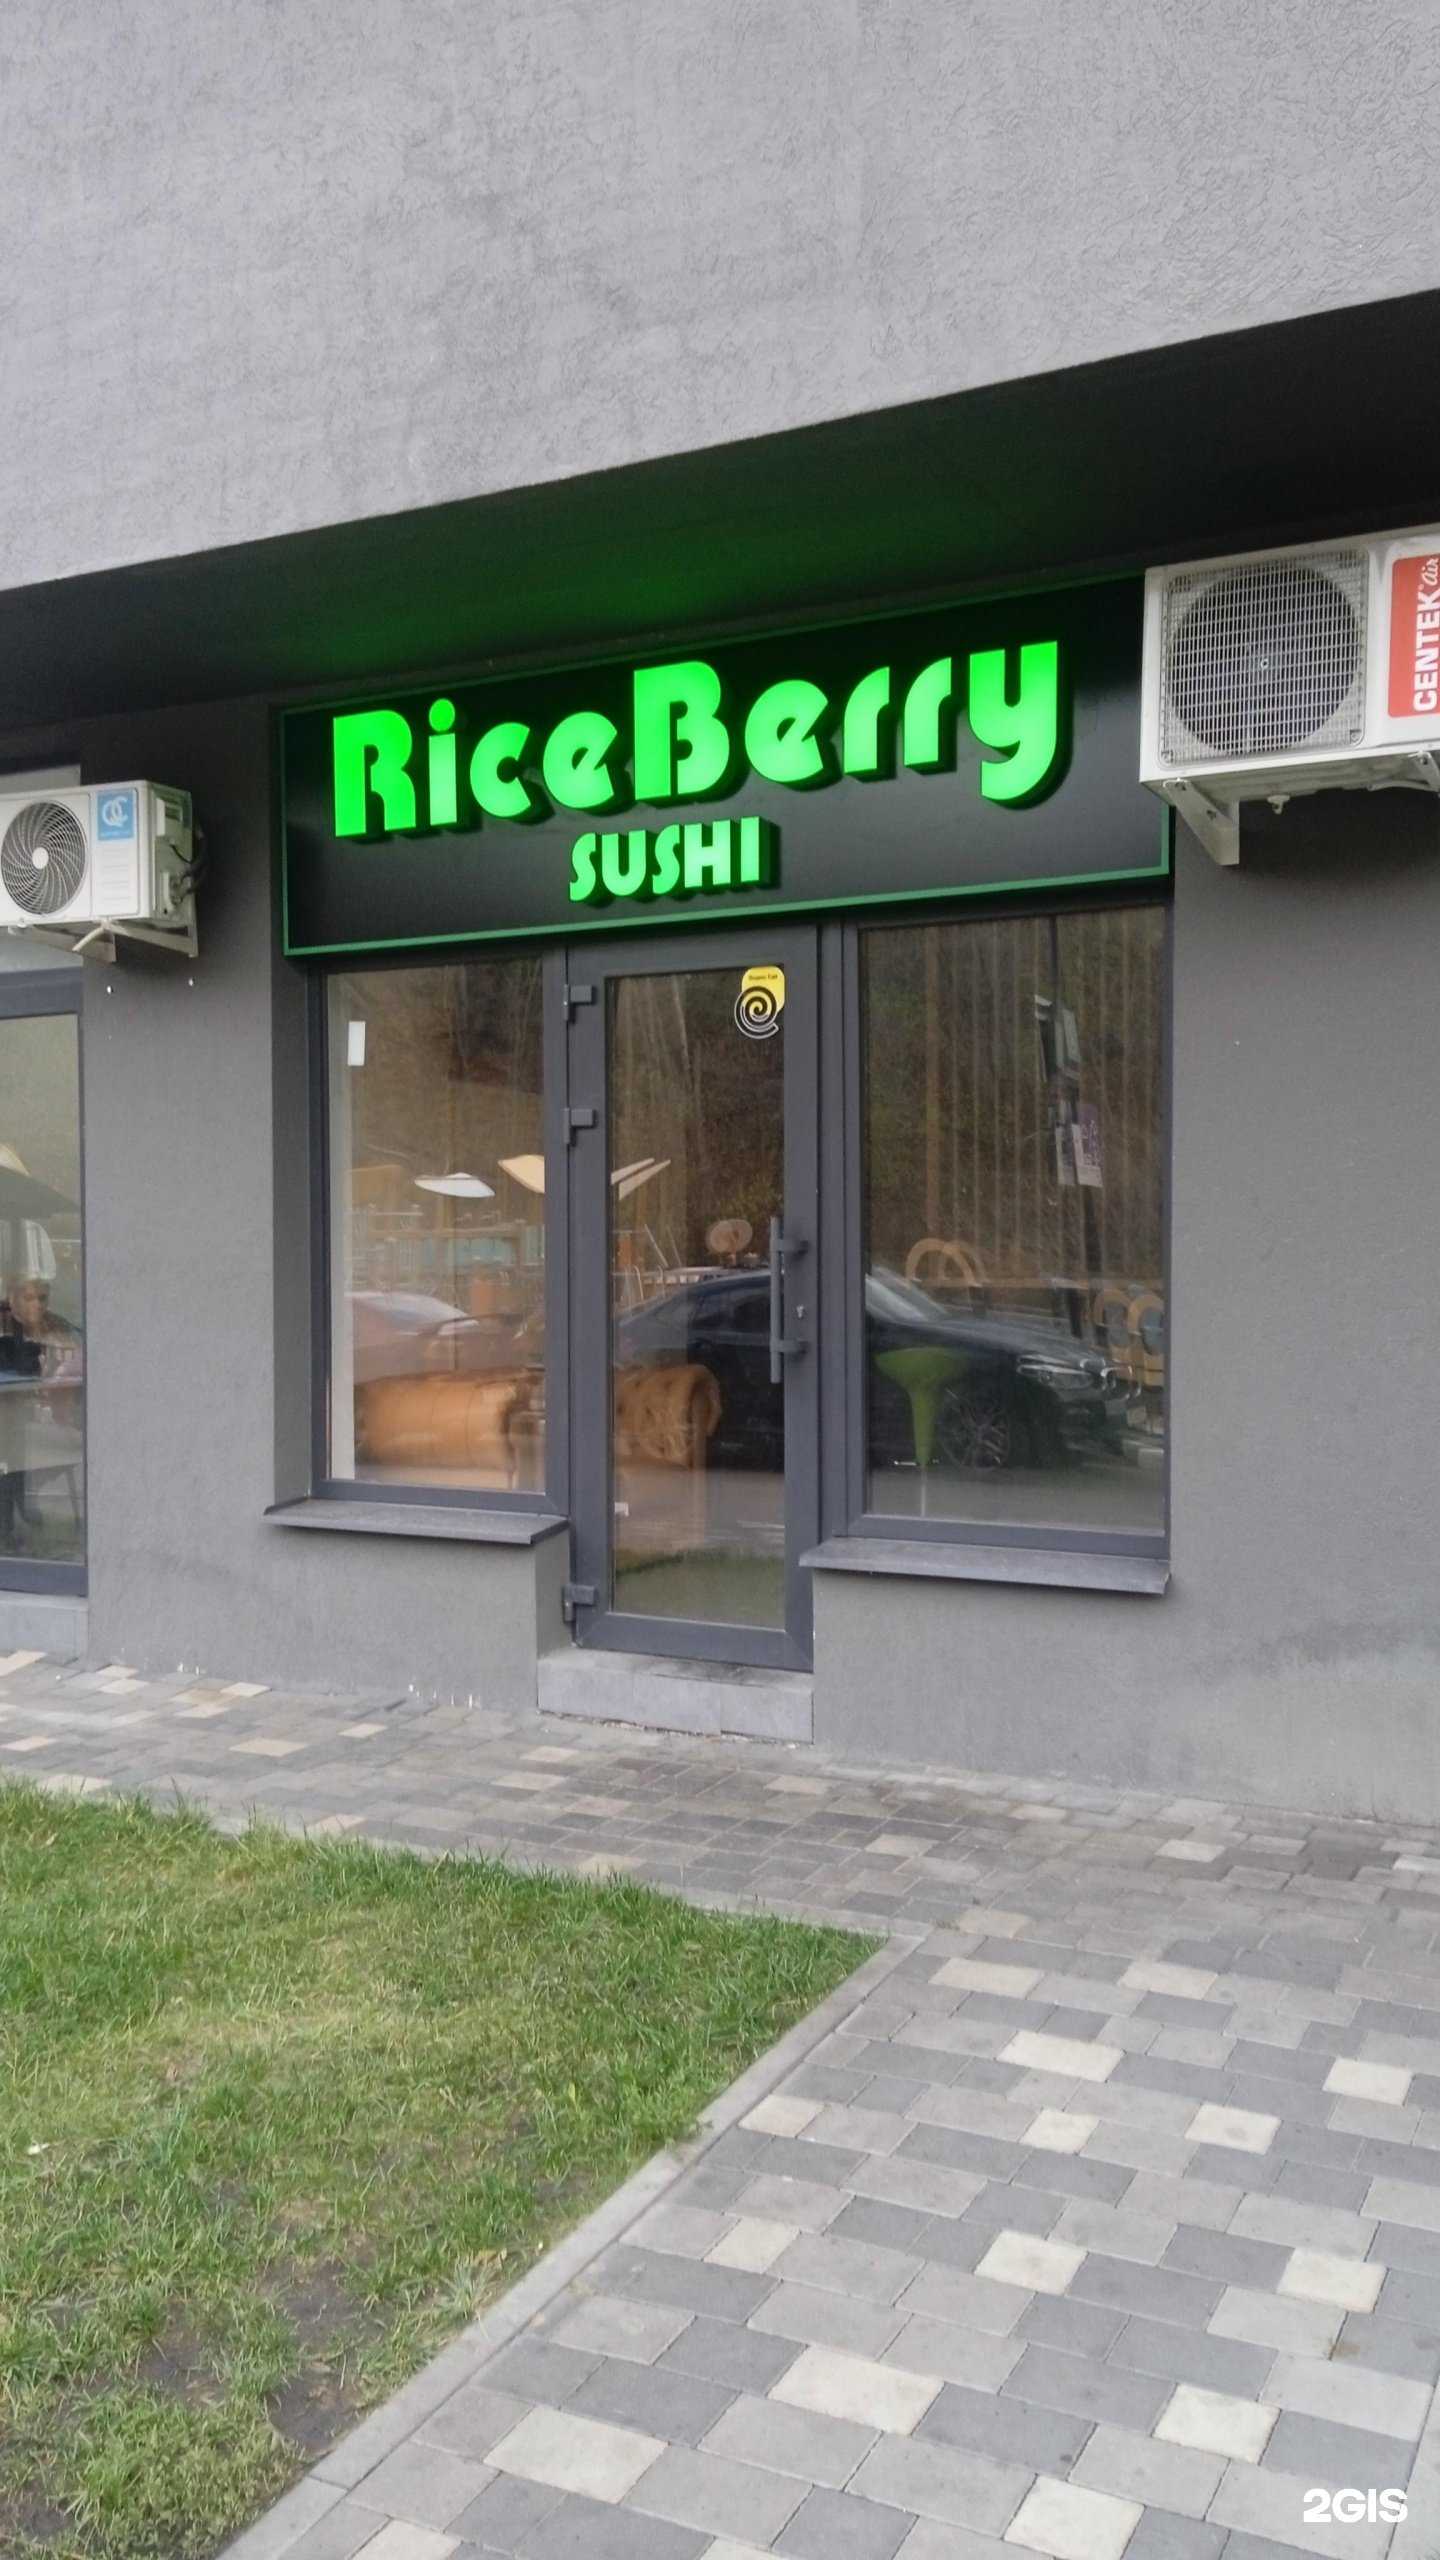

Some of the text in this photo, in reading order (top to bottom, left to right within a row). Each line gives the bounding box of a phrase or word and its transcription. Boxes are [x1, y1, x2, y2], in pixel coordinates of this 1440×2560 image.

[1412, 588, 1440, 712] CENTEK
[333, 640, 1059, 838] RiceBerry
[569, 816, 761, 903] SUSHI
